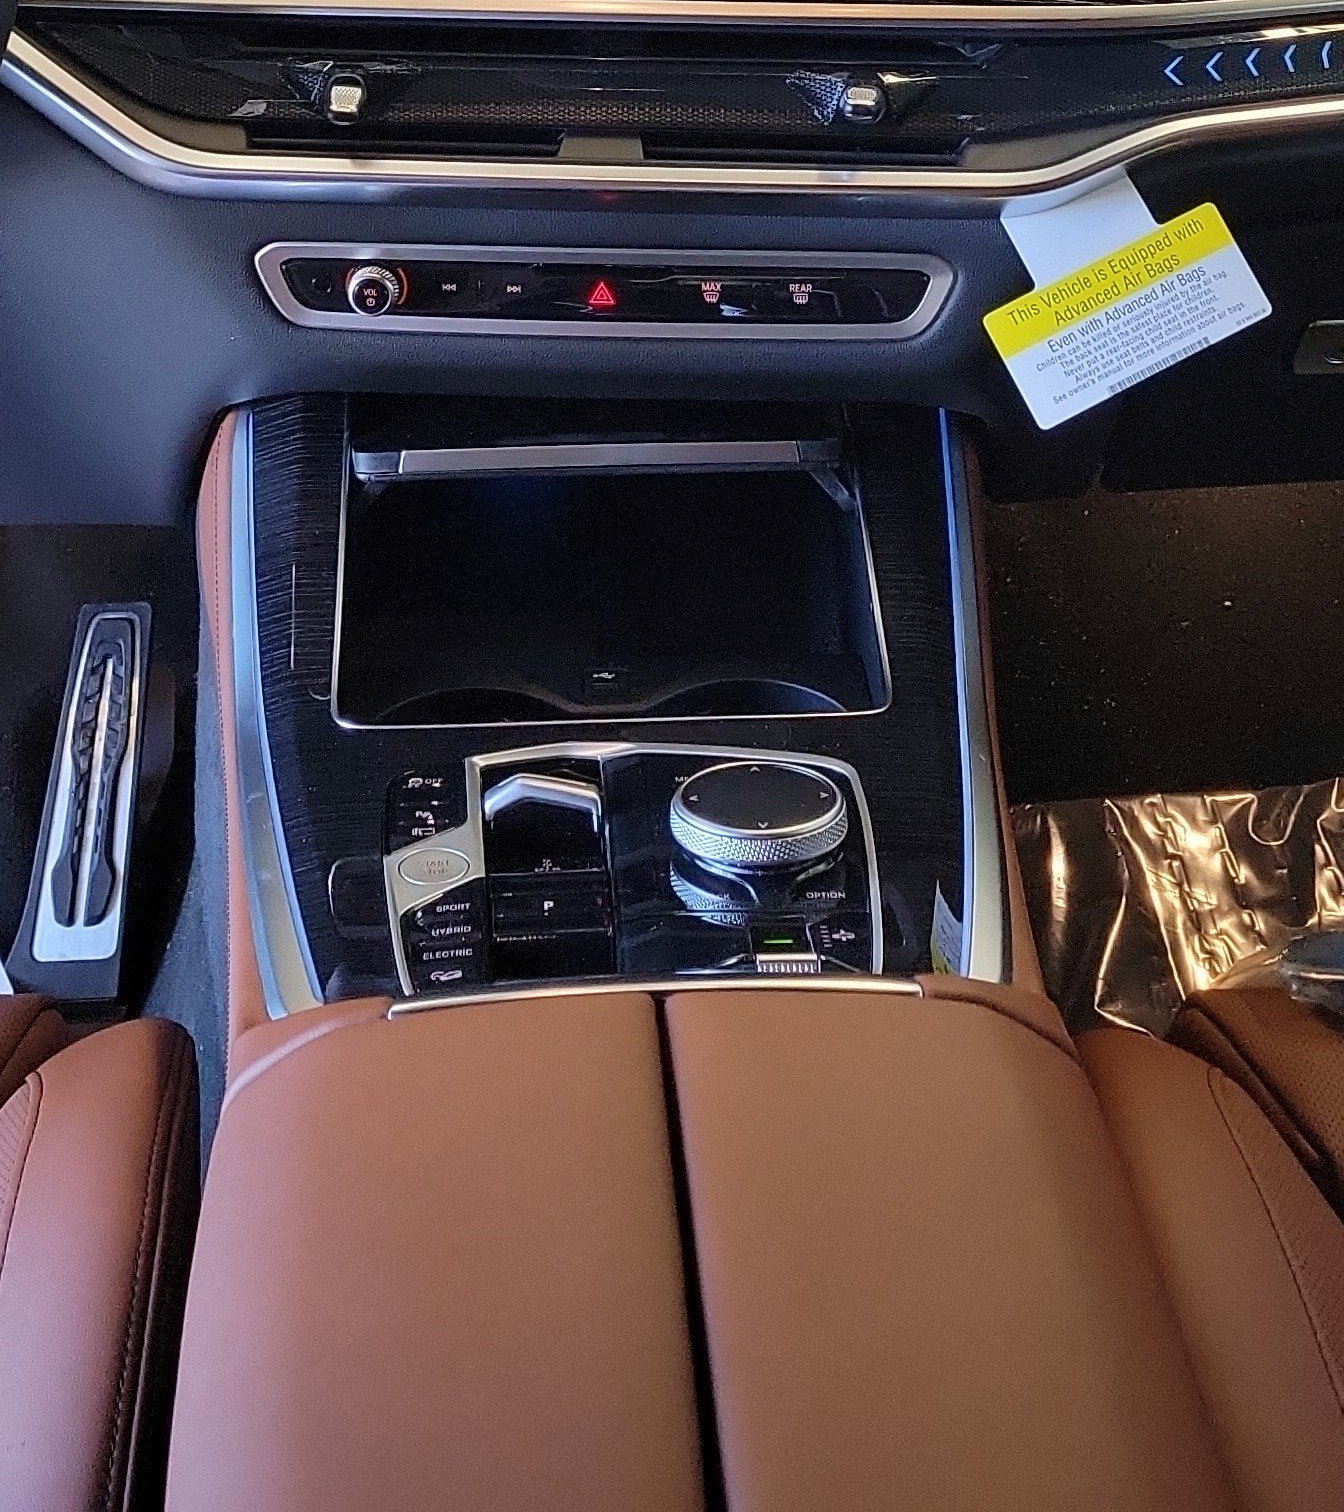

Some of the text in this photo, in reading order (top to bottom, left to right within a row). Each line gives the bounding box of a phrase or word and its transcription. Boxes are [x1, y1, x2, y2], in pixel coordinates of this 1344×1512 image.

[701, 281, 722, 291] MAX
[789, 283, 813, 293] REAR
[1006, 218, 1204, 325] This Vehicle is Equipped with
[1054, 254, 1180, 326] Advanced Air Bags
[362, 288, 378, 297] VOL
[1046, 266, 1206, 352] Even with Advanced Air Bags
[1036, 352, 1066, 371] Children
[1067, 345, 1080, 355] can
[1080, 339, 1091, 348] be
[1091, 327, 1111, 342] killed
[1112, 323, 1120, 332] or
[1121, 307, 1153, 327] seriously
[1153, 292, 1179, 310] injured
[1189, 283, 1201, 292] the
[1202, 277, 1212, 286] air
[1059, 358, 1074, 368] The
[1074, 348, 1092, 361] back
[1093, 340, 1109, 352] seat
[1116, 330, 1129, 339] the
[1130, 317, 1152, 333] safest
[1152, 308, 1171, 323] place
[1171, 302, 1182, 311] for
[1063, 363, 1084, 377] Never
[1086, 355, 1099, 367] put
[1105, 333, 1144, 356] rear-facing
[1144, 322, 1162, 336] child
[1163, 314, 1178, 326] seat
[1186, 304, 1199, 314] the
[1052, 393, 1067, 404] See
[1068, 378, 1096, 396] owner's
[1097, 362, 1123, 381] manual
[1123, 357, 1134, 367] for
[1135, 348, 1154, 361] more
[1155, 326, 1195, 351] information
[1196, 315, 1217, 330] about
[1216, 310, 1226, 319] air
[1074, 366, 1100, 382] Always
[1100, 358, 1113, 369] use
[1115, 349, 1131, 361] seat
[1130, 340, 1149, 353] belts
[1150, 331, 1163, 343] and
[1164, 322, 1182, 336] child
[436, 902, 471, 913] SPORT
[543, 900, 554, 911] P
[806, 890, 846, 900] OPTION
[431, 925, 472, 937] HYBRID
[422, 947, 473, 961] ELECTRIC
